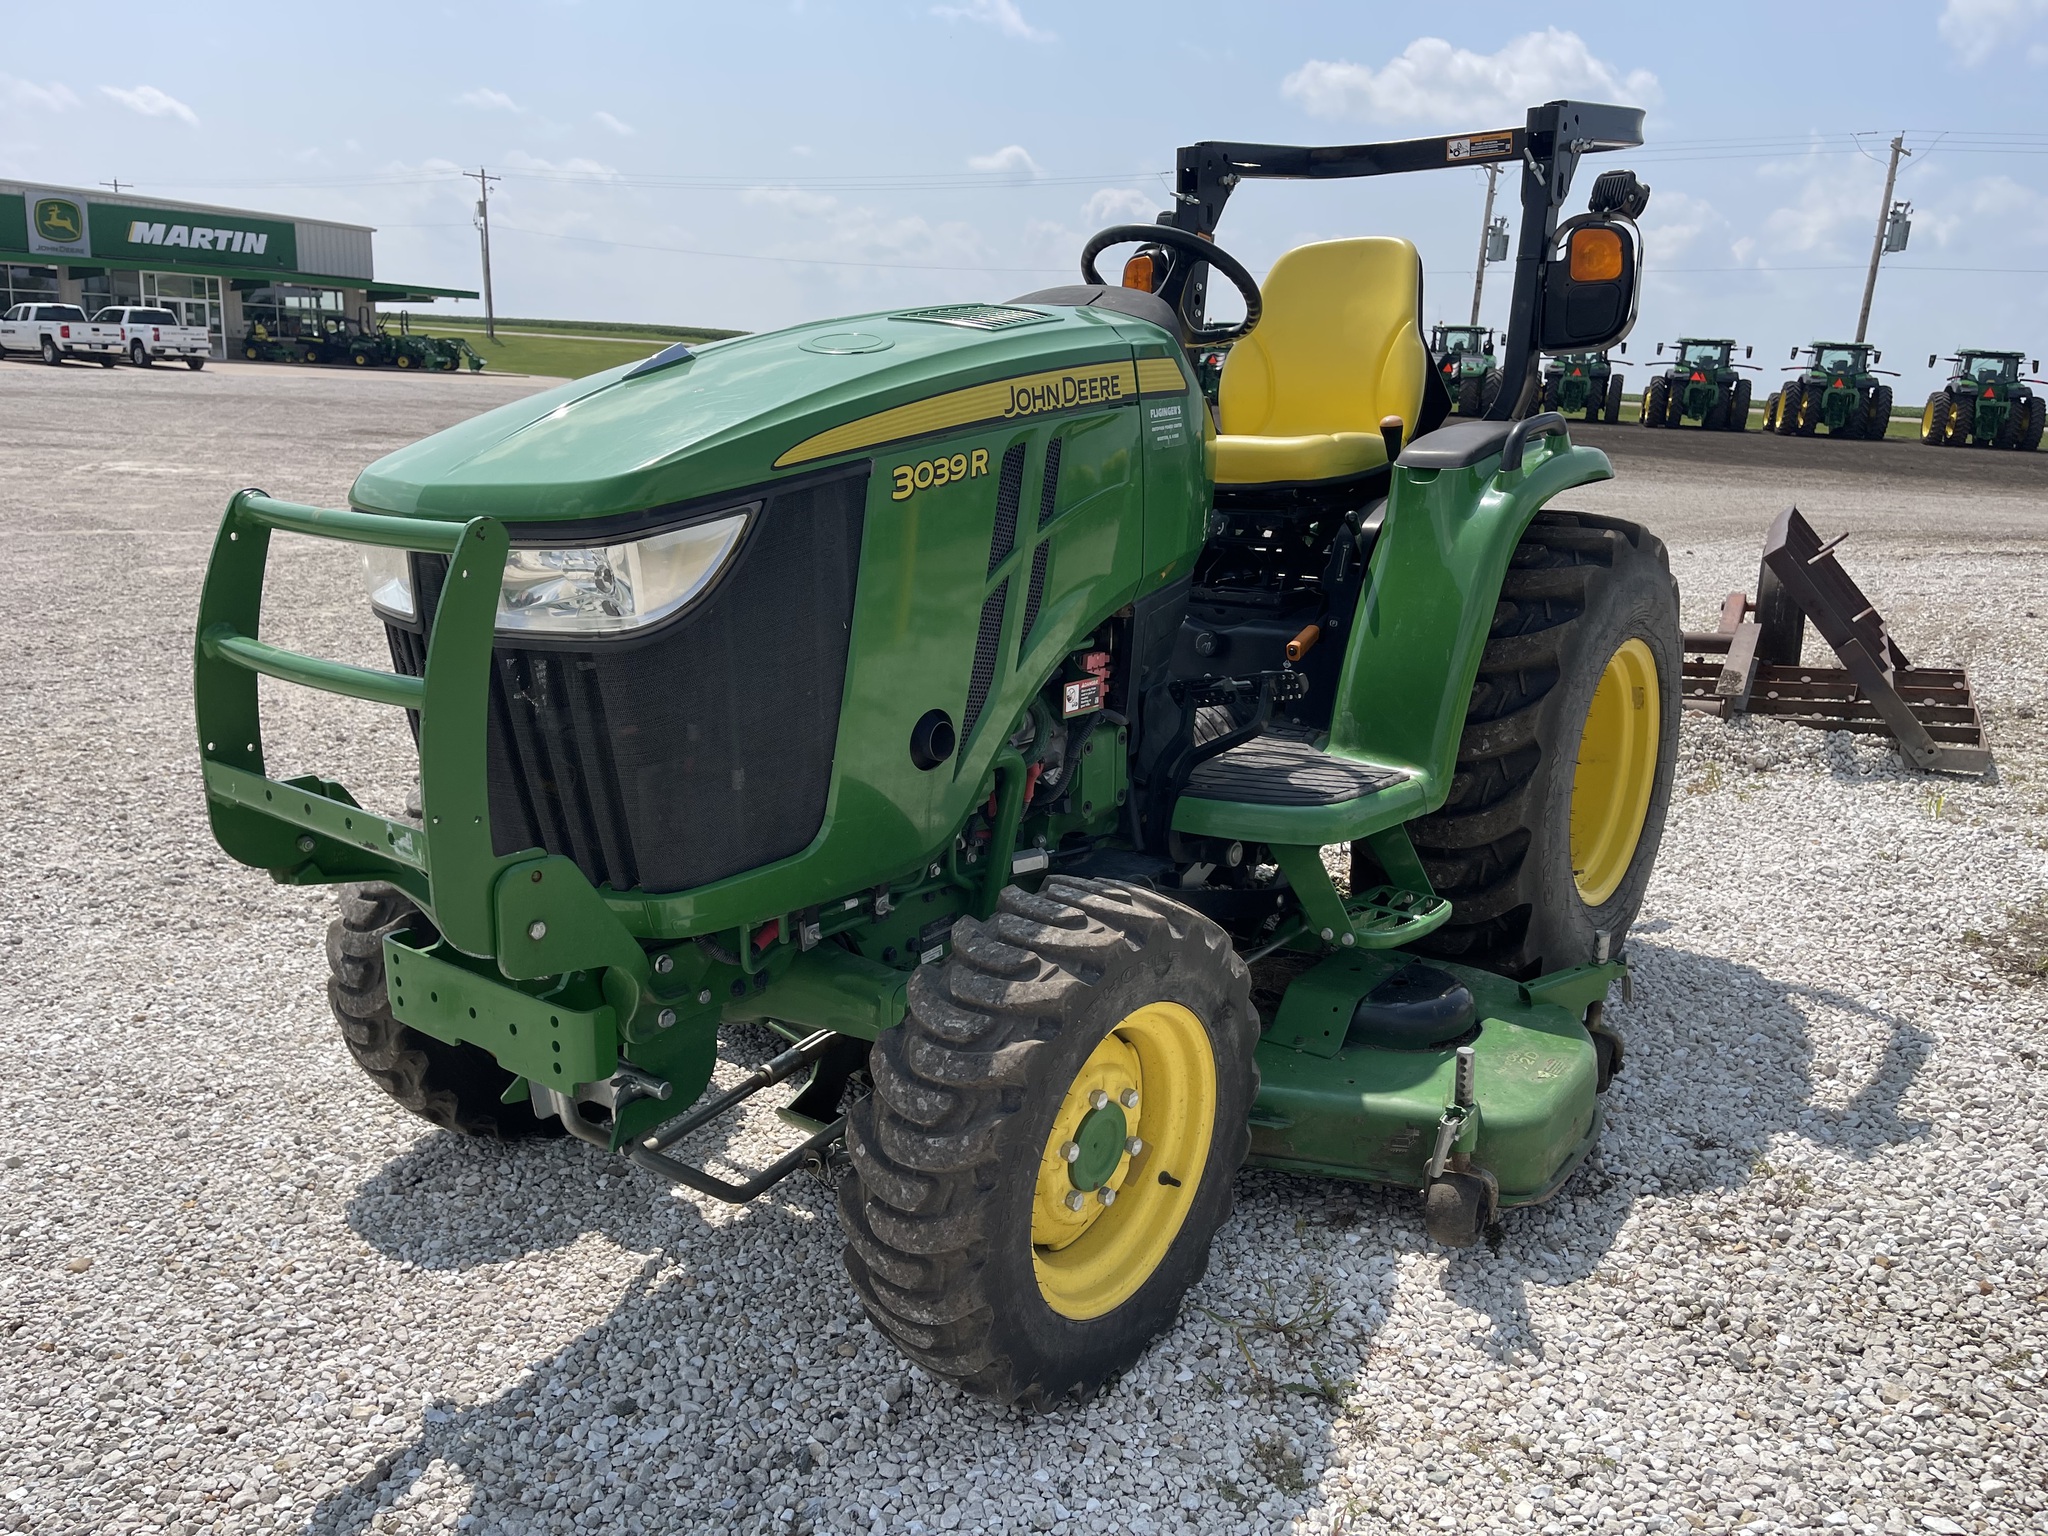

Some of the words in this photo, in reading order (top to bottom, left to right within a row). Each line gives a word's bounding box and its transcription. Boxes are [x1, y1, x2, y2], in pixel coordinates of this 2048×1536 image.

[128, 221, 268, 255] MARTIN
[1004, 384, 1060, 416] JOHN
[1062, 375, 1121, 406] DEERE
[1543, 743, 1562, 907] GALAXY
[1520, 1051, 1539, 1070] 2D
